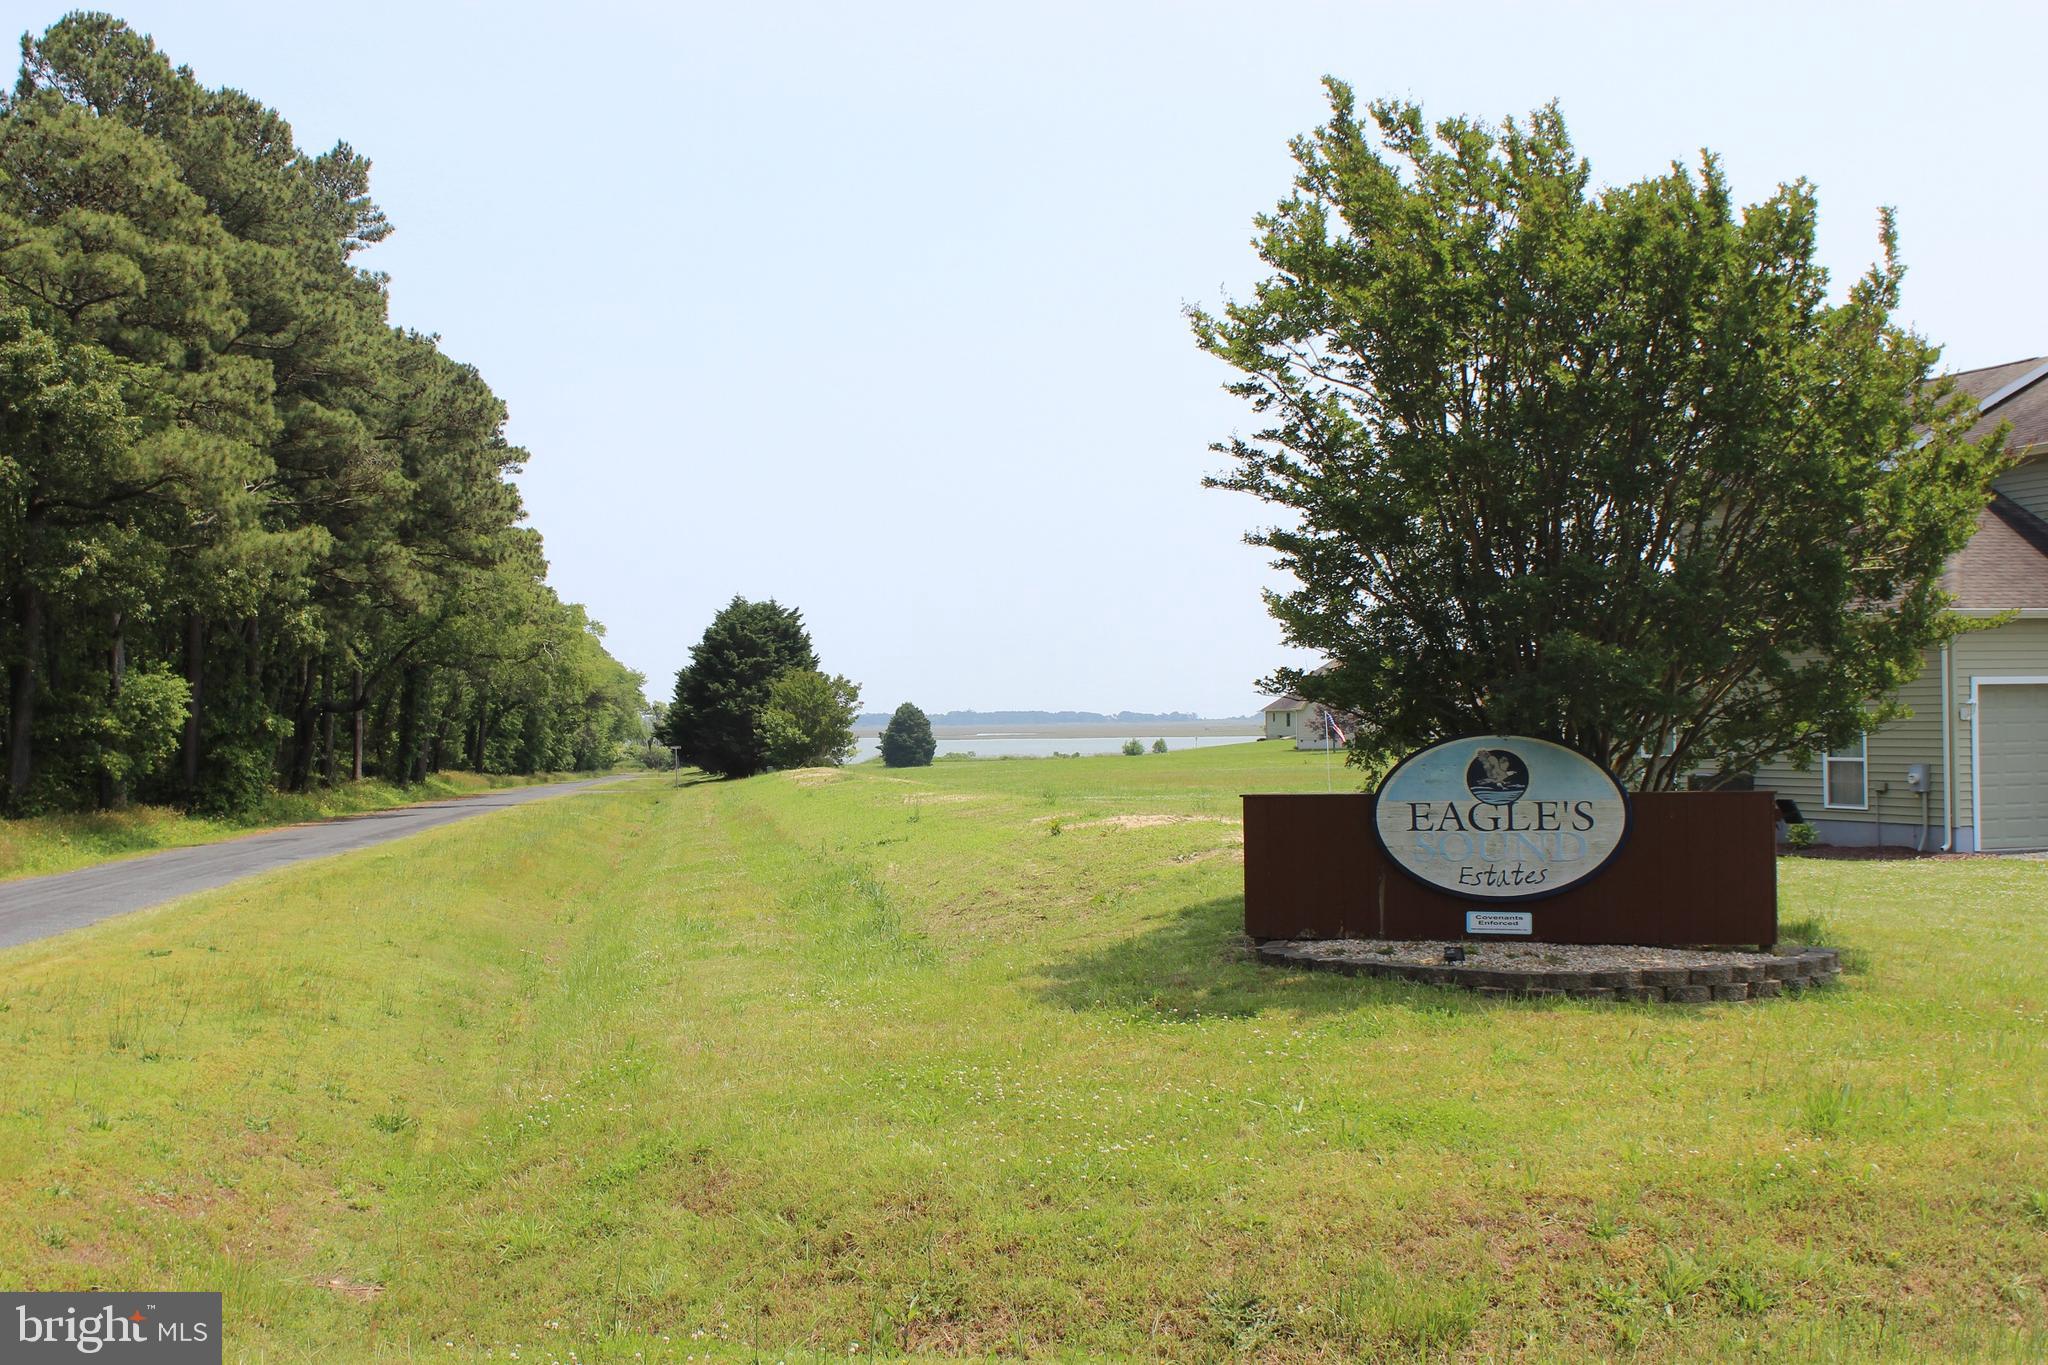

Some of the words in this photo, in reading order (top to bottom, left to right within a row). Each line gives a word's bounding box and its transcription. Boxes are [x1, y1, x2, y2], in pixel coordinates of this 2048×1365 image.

[1407, 801, 1595, 832] EAGLE'S
[1413, 832, 1586, 863] SOUND
[1458, 863, 1549, 887] Estates
